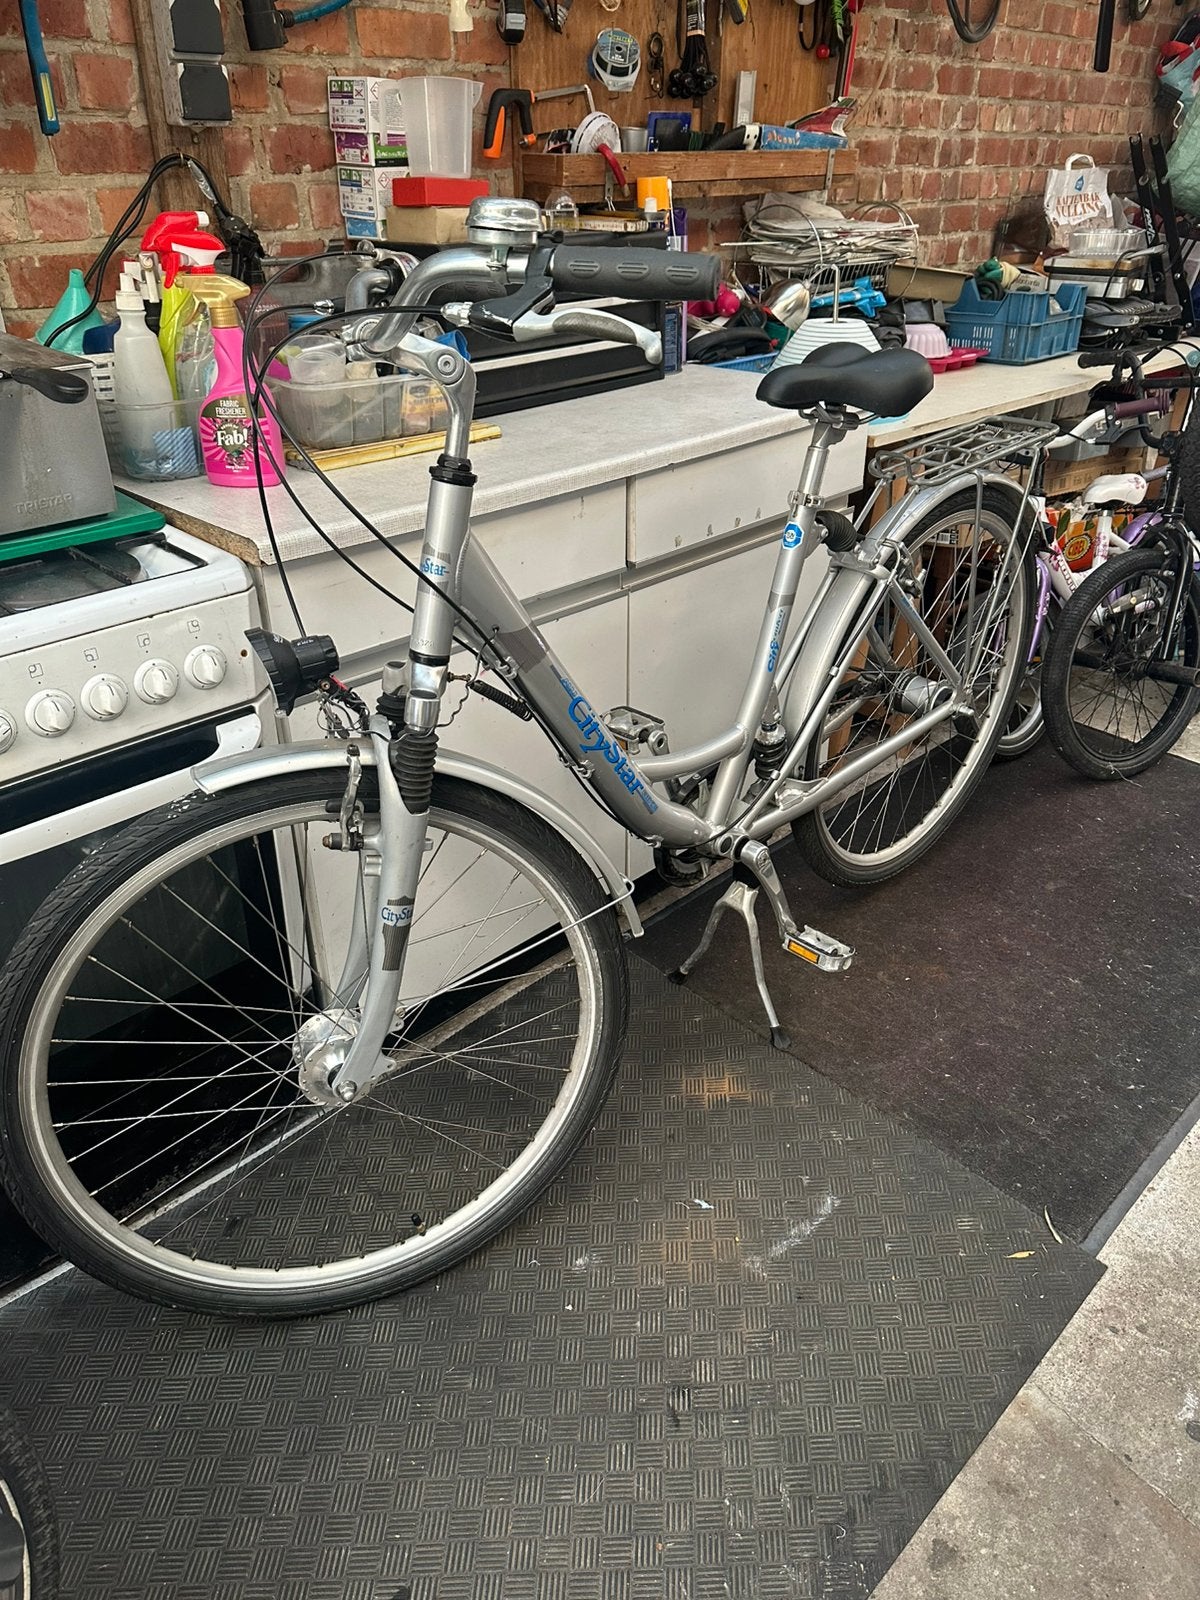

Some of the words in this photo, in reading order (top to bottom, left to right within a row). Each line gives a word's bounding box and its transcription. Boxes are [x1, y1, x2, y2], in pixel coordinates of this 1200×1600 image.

[215, 407, 247, 415] FRESHENER
[216, 428, 249, 447] Fab!
[16, 493, 72, 513] TRISTAR
[568, 696, 644, 795] CityStar
